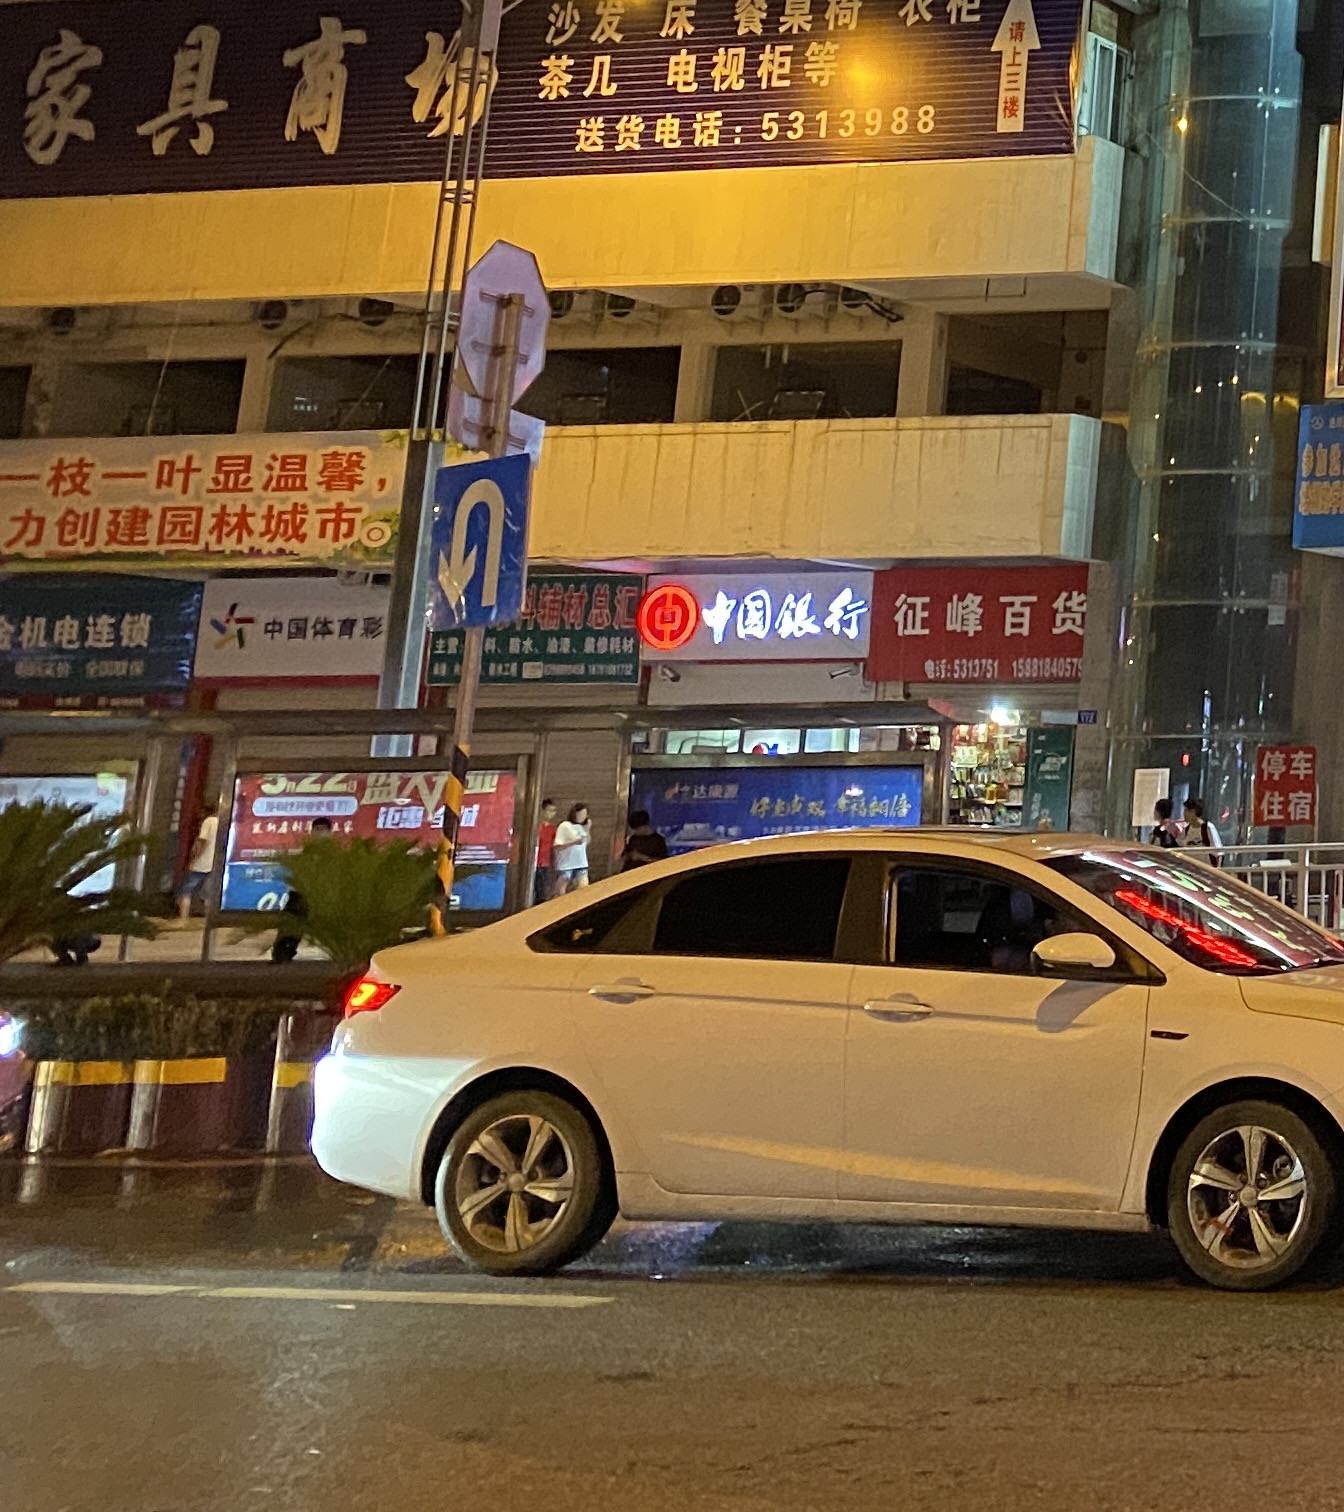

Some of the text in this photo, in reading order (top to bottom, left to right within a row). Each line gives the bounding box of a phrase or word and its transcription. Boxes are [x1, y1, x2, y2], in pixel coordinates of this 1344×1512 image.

[538, 40, 841, 101] 茶几 电视柜等
[1002, 20, 1027, 119] 请上三楼
[702, 587, 870, 645] 中国银行
[894, 590, 1087, 639] 征峰百货
[1261, 750, 1314, 781] 停车
[1260, 790, 1312, 822] 住宿
